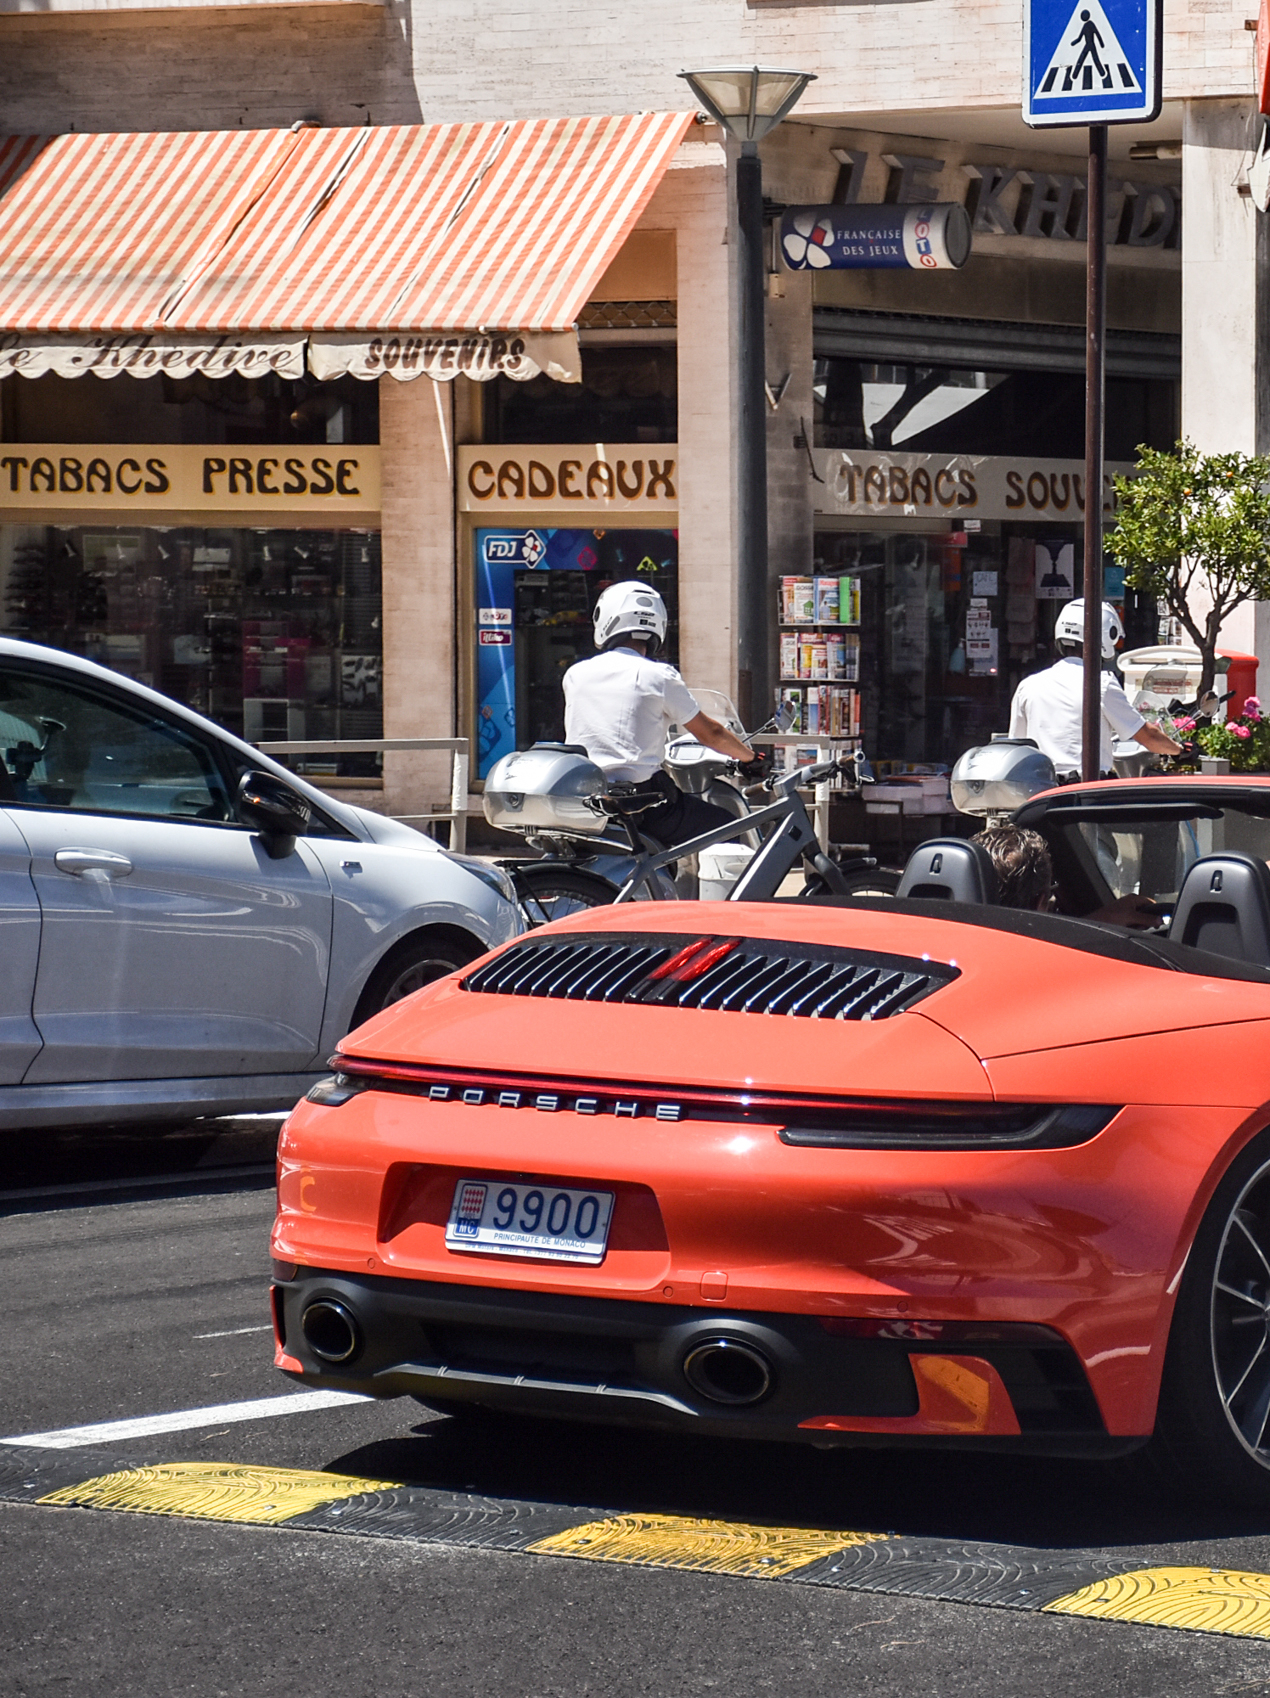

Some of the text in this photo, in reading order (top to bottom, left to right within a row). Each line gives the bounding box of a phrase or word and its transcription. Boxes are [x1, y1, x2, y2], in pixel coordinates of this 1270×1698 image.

[843, 245, 899, 257] DES JEUX
[0, 456, 361, 496] TABACS PRESSE
[467, 459, 678, 501] CADEAUX
[839, 464, 979, 509] TABACS
[488, 541, 517, 557] FDJ
[428, 1085, 681, 1122] PORSCHE
[458, 1220, 477, 1236] MC
[492, 1187, 600, 1239] 9900
[493, 1233, 586, 1249] PRINCIPAUTE DE MONACO
